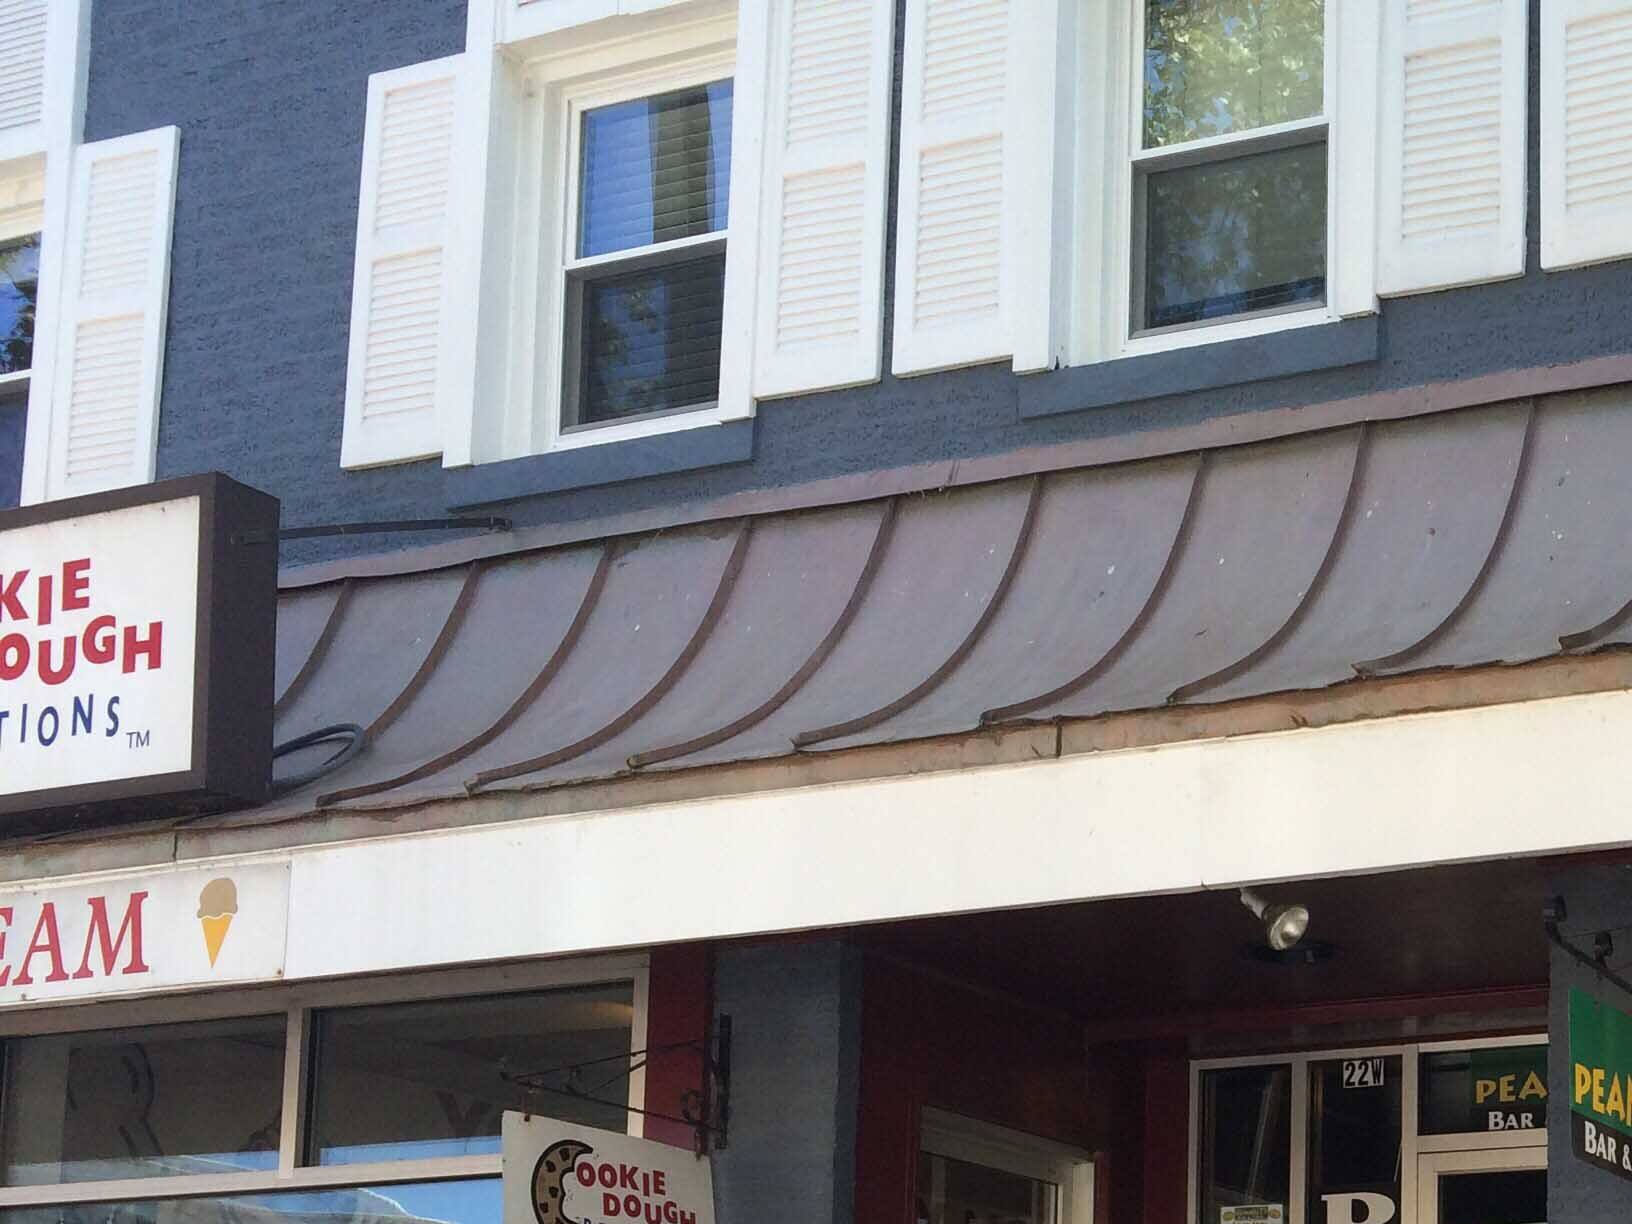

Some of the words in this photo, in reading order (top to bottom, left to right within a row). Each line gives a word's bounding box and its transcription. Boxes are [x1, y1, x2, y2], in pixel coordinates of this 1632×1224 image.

[1488, 1111, 1534, 1131] BAR
[1584, 1120, 1617, 1165] BAR
[1622, 1143, 1632, 1172] &
